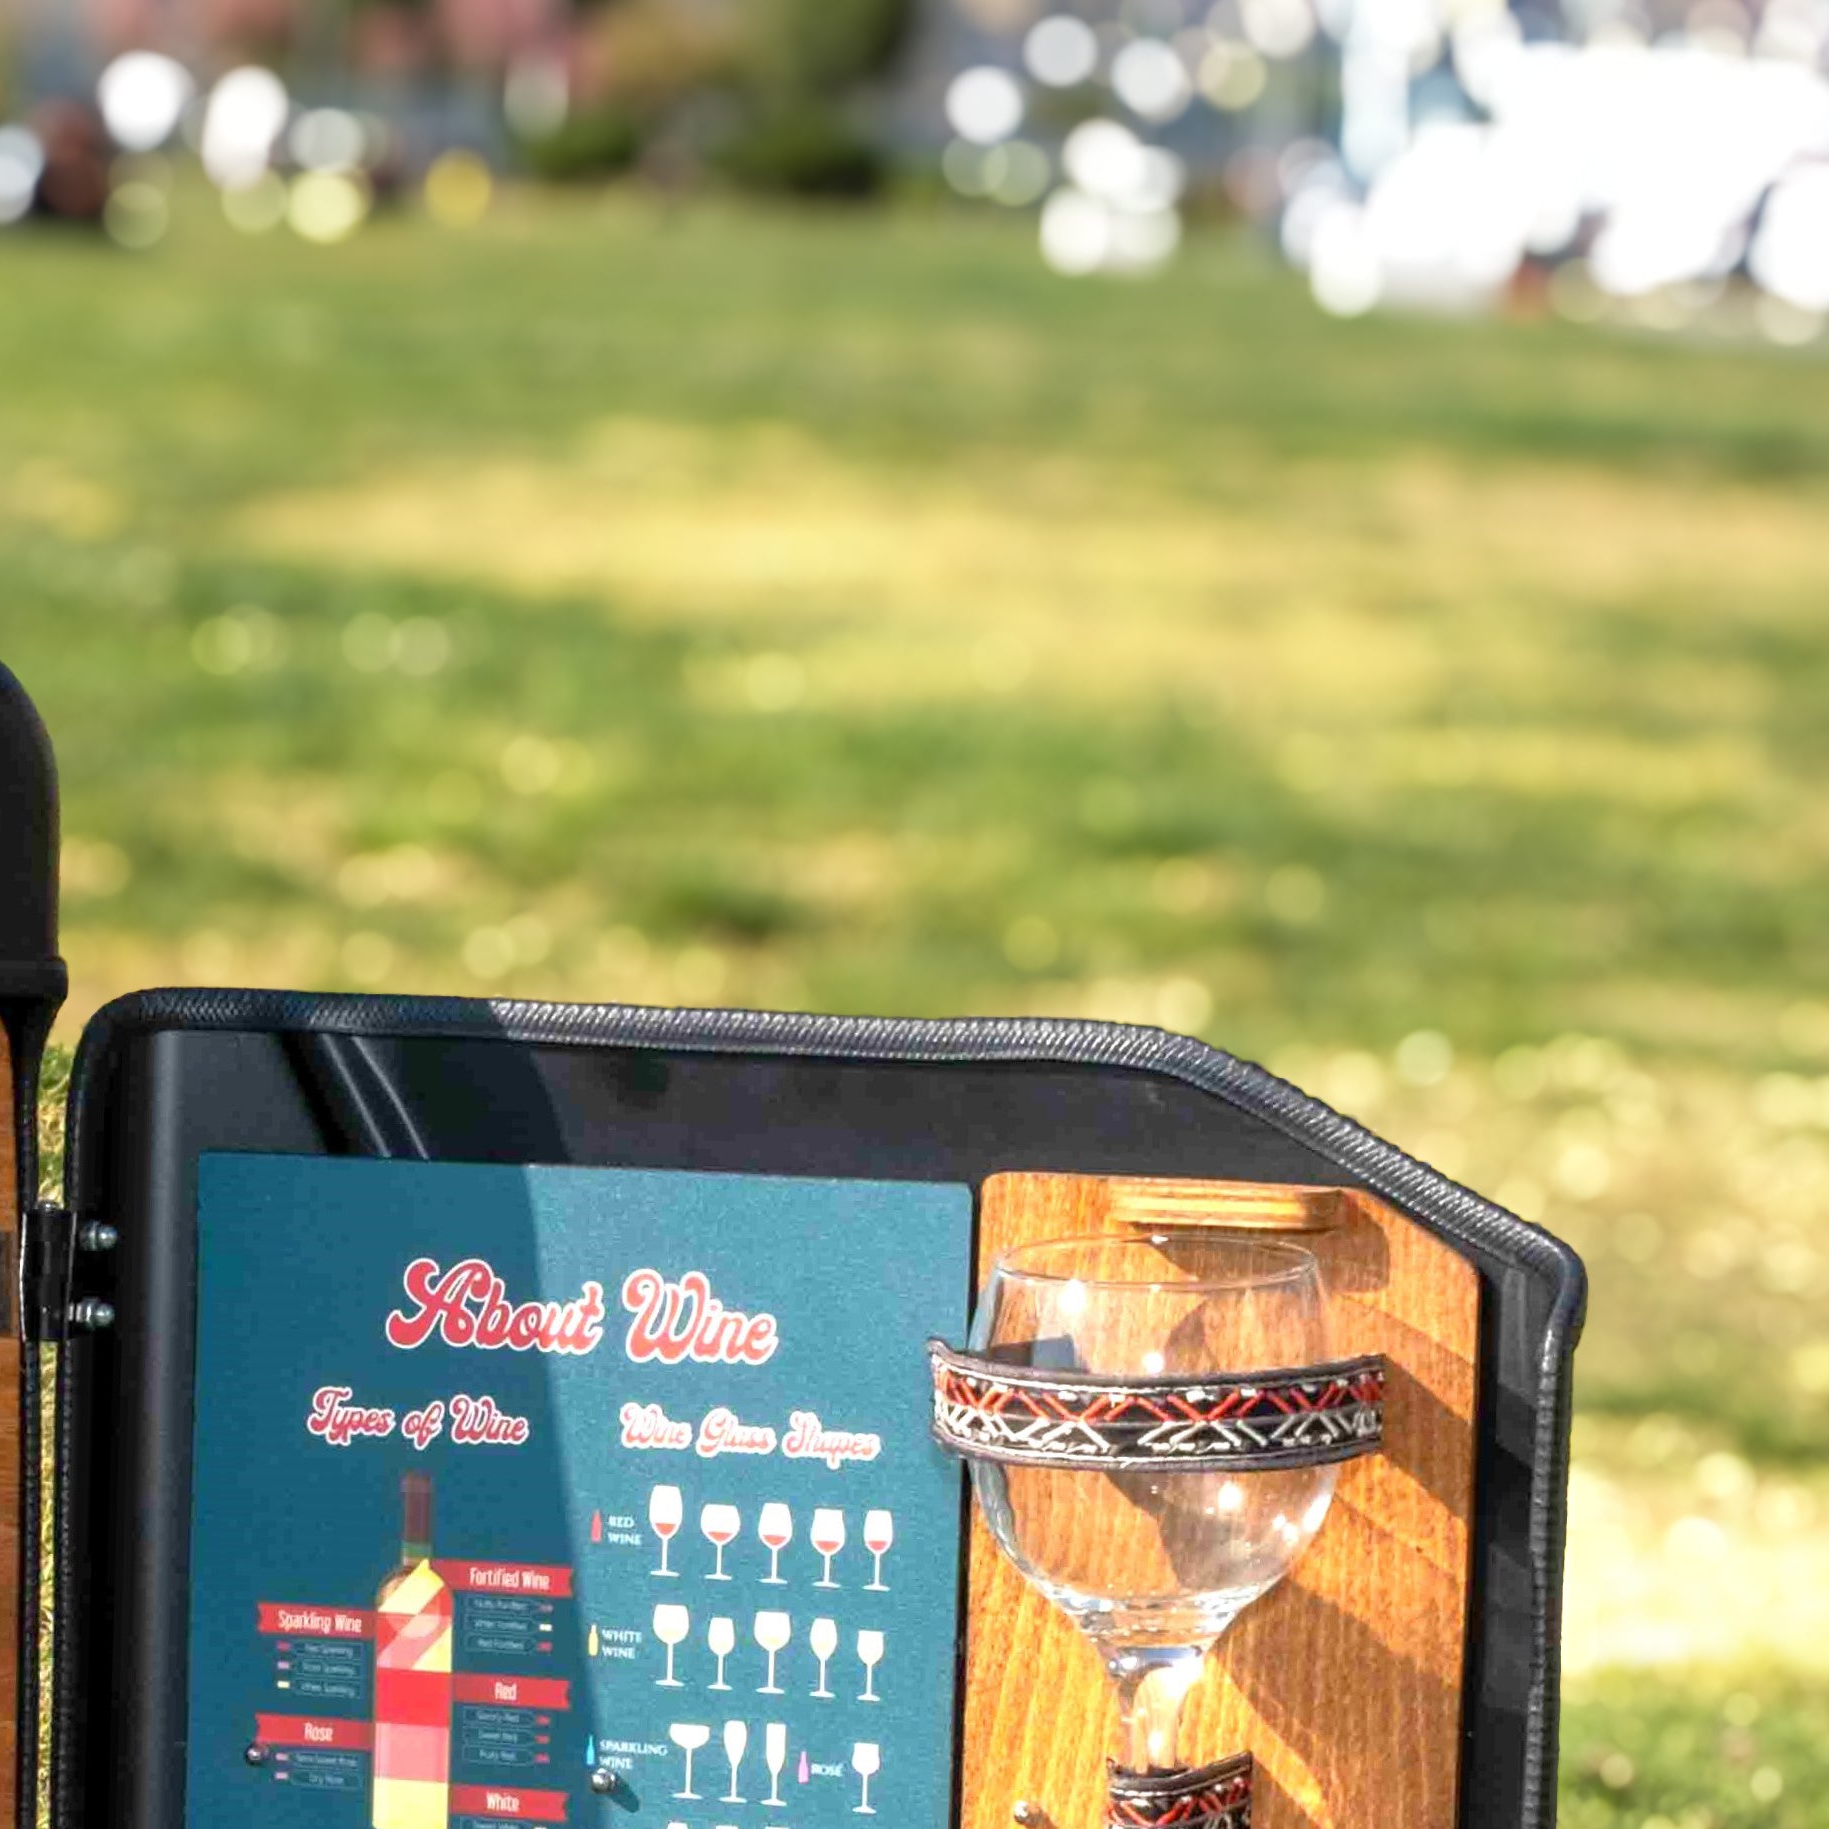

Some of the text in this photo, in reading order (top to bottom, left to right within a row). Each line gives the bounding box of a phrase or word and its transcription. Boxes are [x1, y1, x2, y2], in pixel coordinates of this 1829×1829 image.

[386, 1258, 778, 1365] About Wine
[307, 1386, 529, 1450] Types of Wine
[620, 1403, 881, 1468] Wine Glass Shapes
[608, 1516, 635, 1528] RED
[608, 1533, 642, 1545] WINE
[470, 1567, 549, 1590] Fortified Wine
[278, 1610, 362, 1634] Sparkling Wine
[602, 1629, 642, 1643] WHITE
[602, 1646, 635, 1659] WINE
[495, 1681, 517, 1700] Red
[304, 1722, 333, 1742] Rose
[599, 1739, 668, 1756] SPARKLING
[599, 1756, 633, 1769] WINE
[486, 1791, 520, 1812] White
